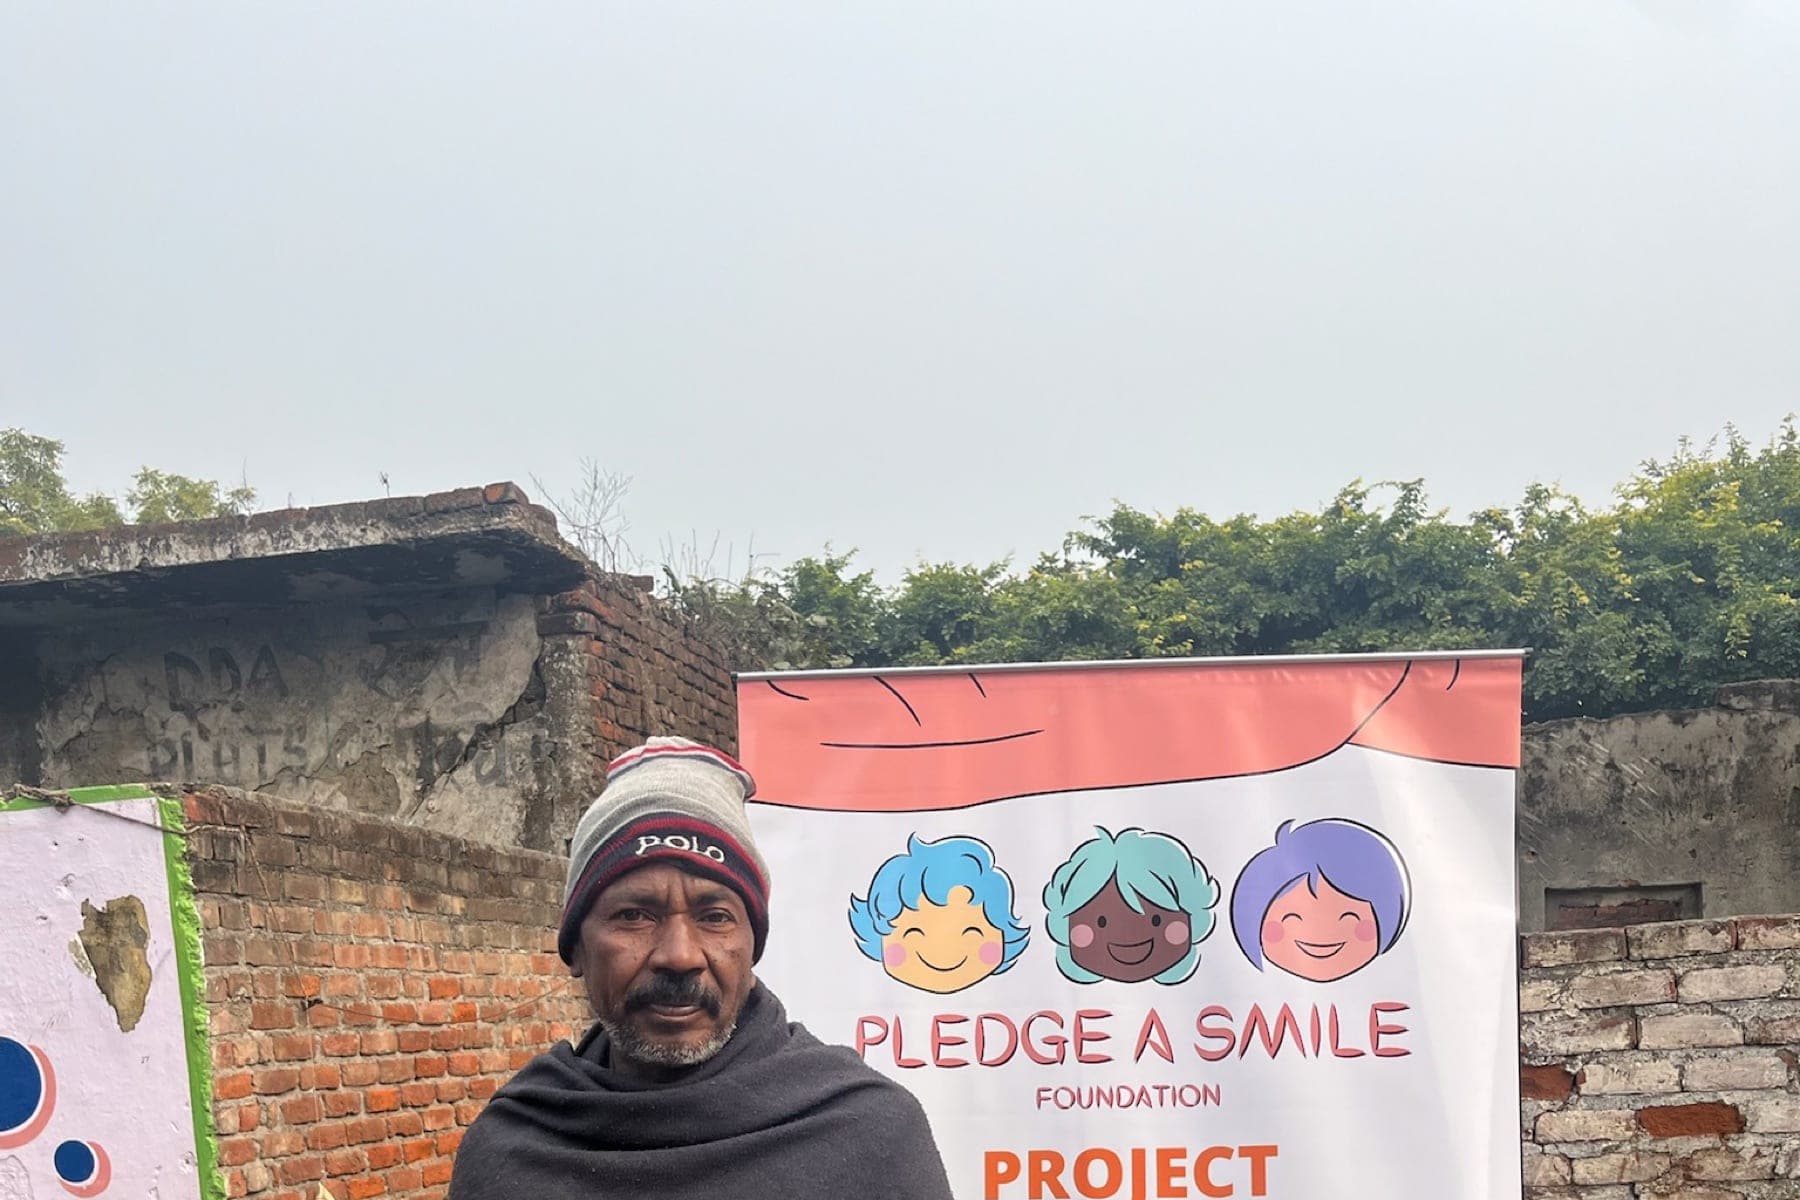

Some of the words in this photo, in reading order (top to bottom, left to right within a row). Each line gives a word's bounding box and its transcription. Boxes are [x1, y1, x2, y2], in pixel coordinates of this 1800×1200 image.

[856, 1009, 1113, 1069] PLEDGE
[1135, 1008, 1175, 1064] A
[1194, 1002, 1411, 1062] SMILE
[1036, 1084, 1221, 1111] FOUNDATION
